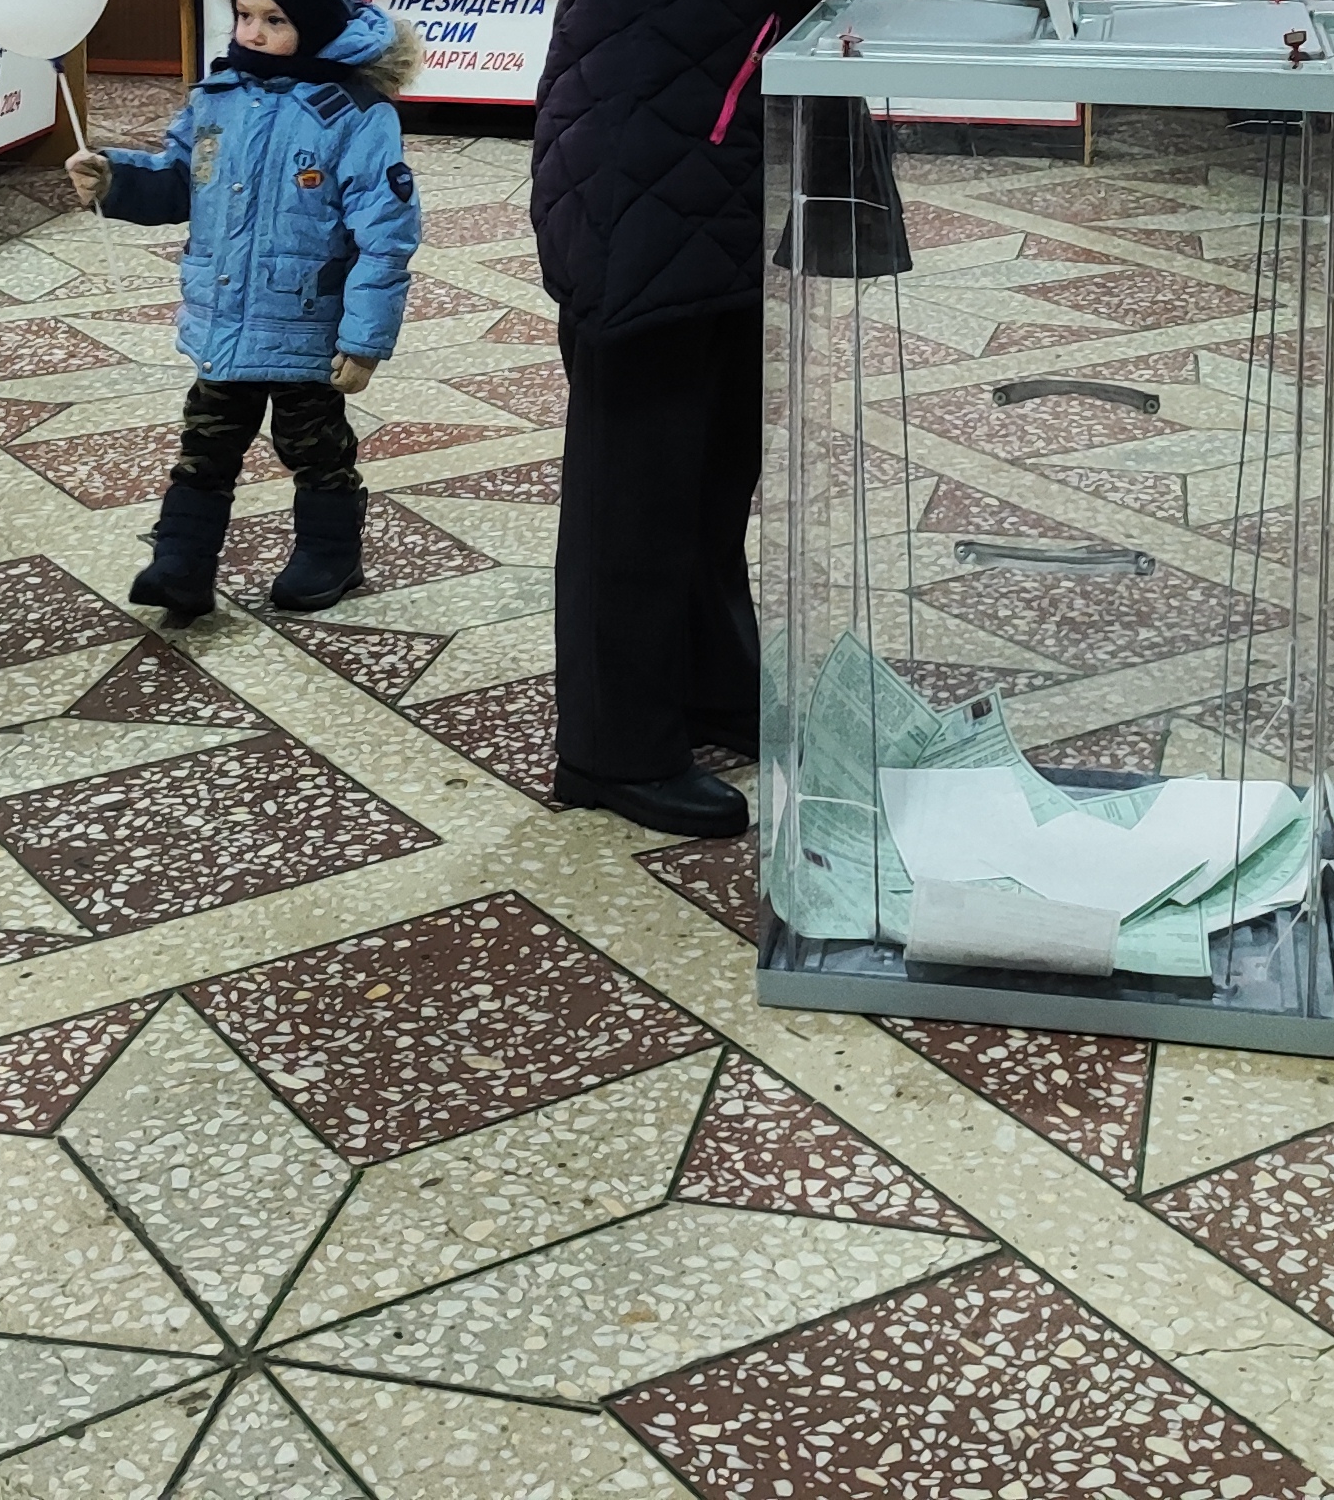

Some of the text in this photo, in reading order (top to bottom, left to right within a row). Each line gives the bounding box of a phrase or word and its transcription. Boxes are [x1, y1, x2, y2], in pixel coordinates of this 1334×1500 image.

[414, 20, 478, 43] ССИИ
[422, 50, 525, 71] МАРТА 2024
